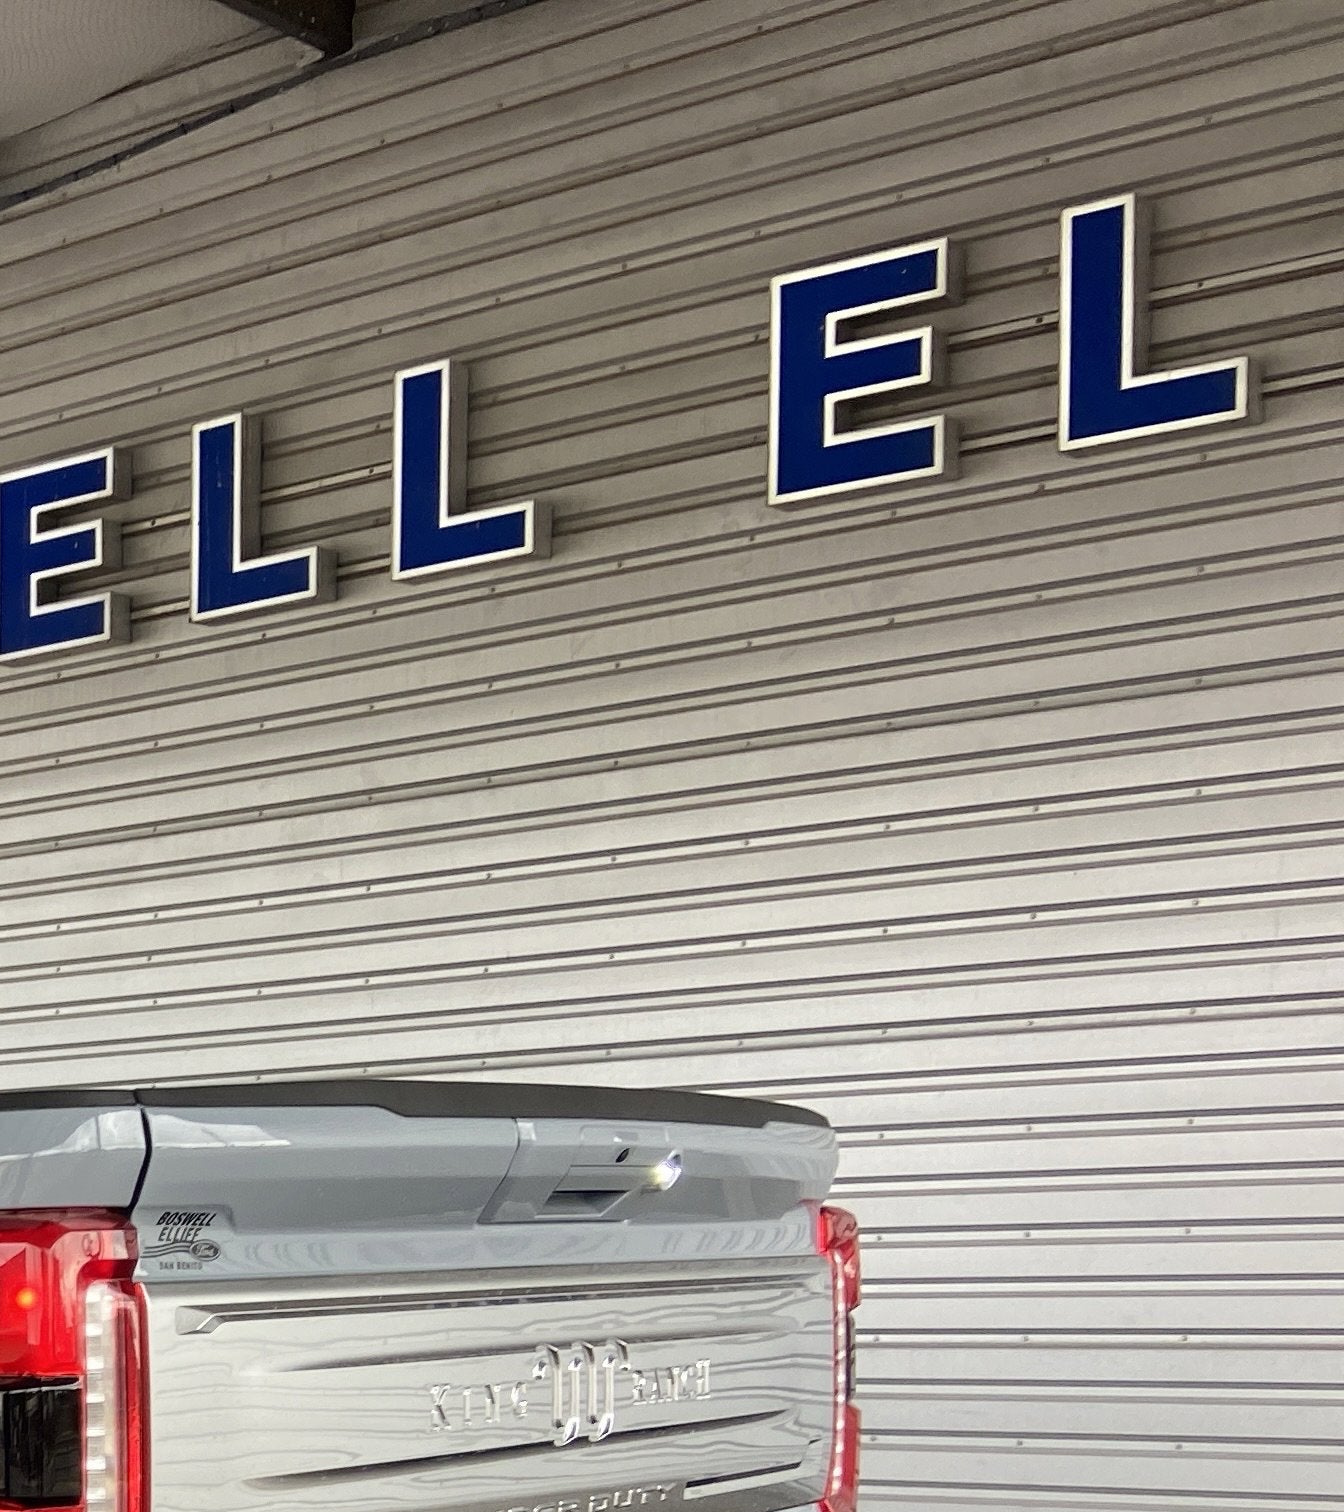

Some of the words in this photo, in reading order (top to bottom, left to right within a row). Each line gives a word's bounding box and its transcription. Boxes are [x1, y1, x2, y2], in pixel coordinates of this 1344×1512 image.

[768, 192, 1250, 507] EL
[155, 1211, 217, 1227] BOSWELL
[429, 1382, 529, 1431] KING
[632, 1358, 712, 1406] RANCH
